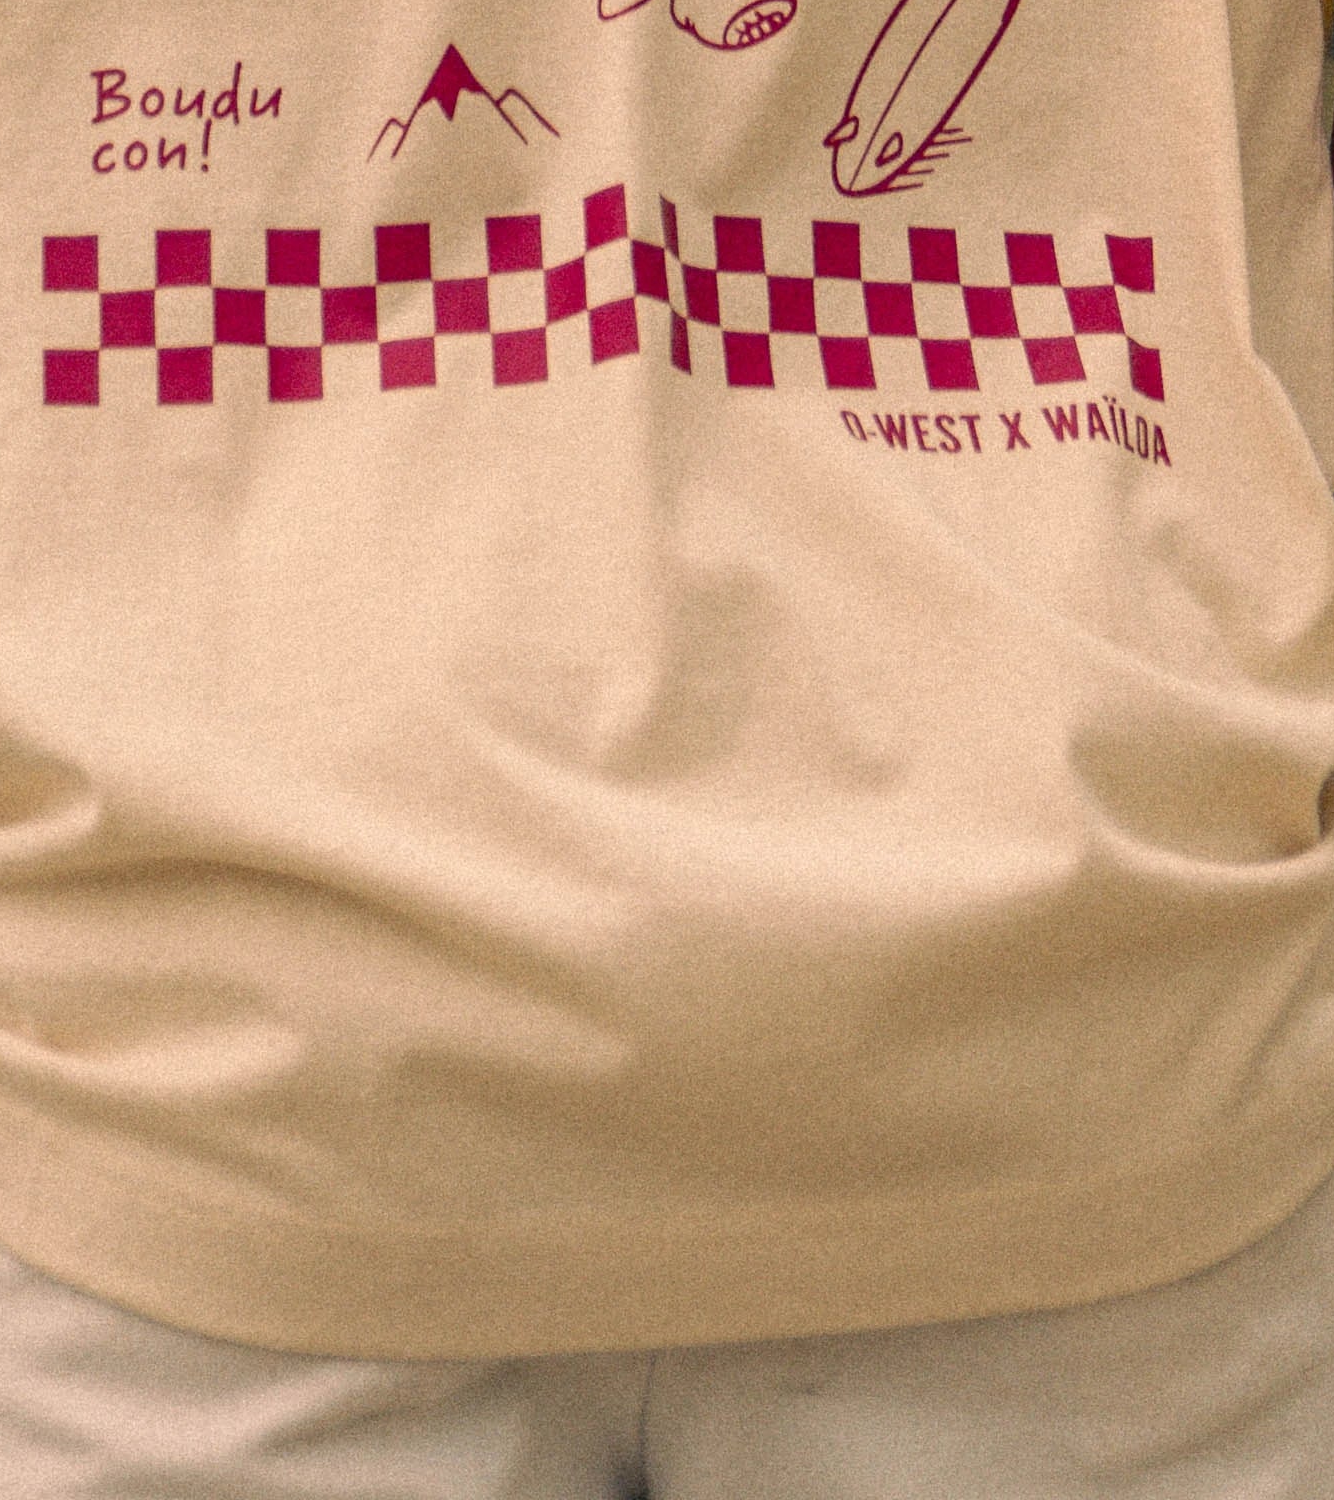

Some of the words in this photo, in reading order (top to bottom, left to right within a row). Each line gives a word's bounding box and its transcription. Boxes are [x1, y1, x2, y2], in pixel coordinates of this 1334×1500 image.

[90, 61, 283, 126] Boudu
[91, 118, 213, 175] con!
[839, 409, 982, 454] O-WEST
[998, 411, 1032, 451] X
